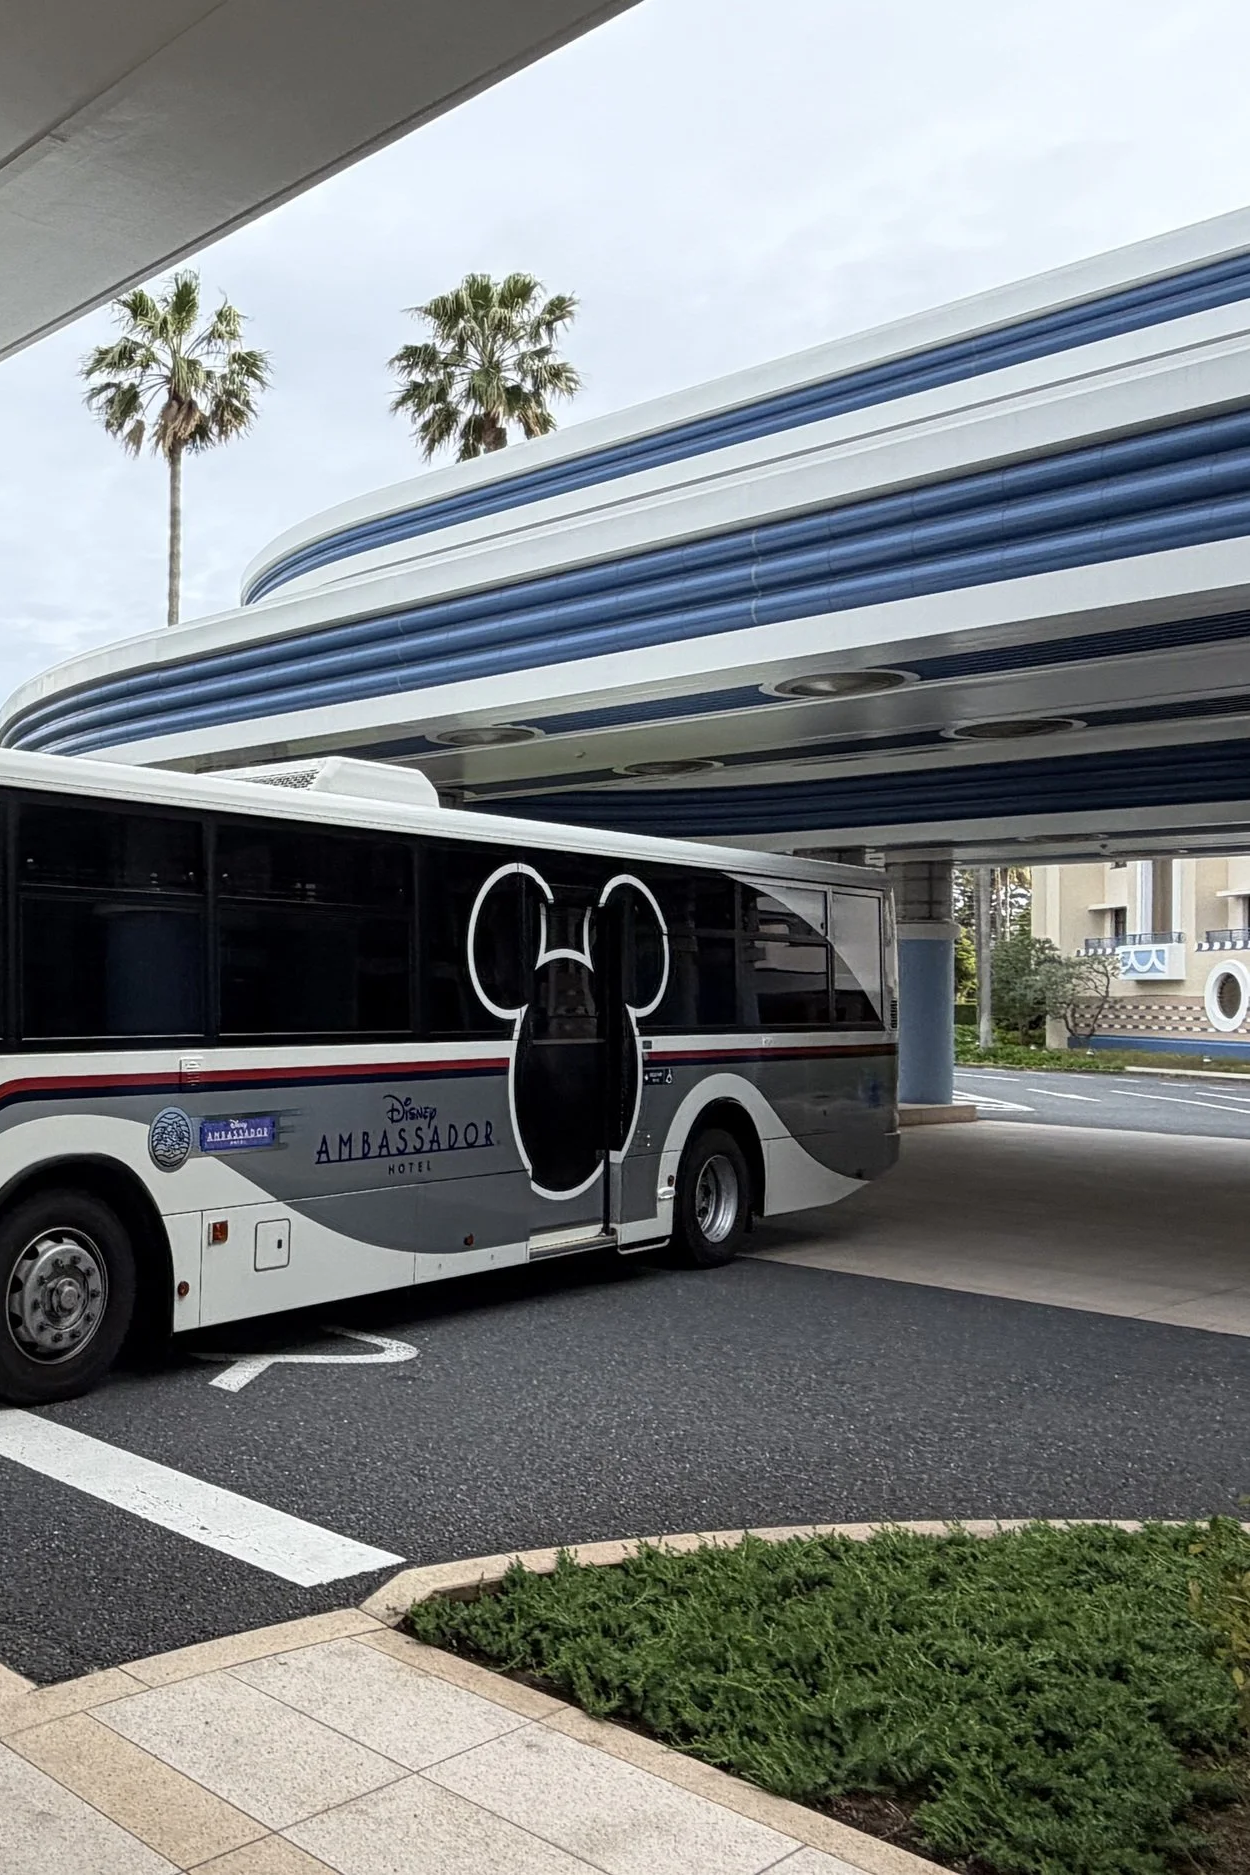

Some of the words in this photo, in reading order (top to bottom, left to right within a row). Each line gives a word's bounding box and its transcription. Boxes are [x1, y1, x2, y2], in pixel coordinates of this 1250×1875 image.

[383, 1094, 438, 1129] Disney
[207, 1127, 268, 1142] AMBASSADOR
[316, 1120, 494, 1164] AMBASSADOR
[388, 1159, 432, 1176] HOTEL
